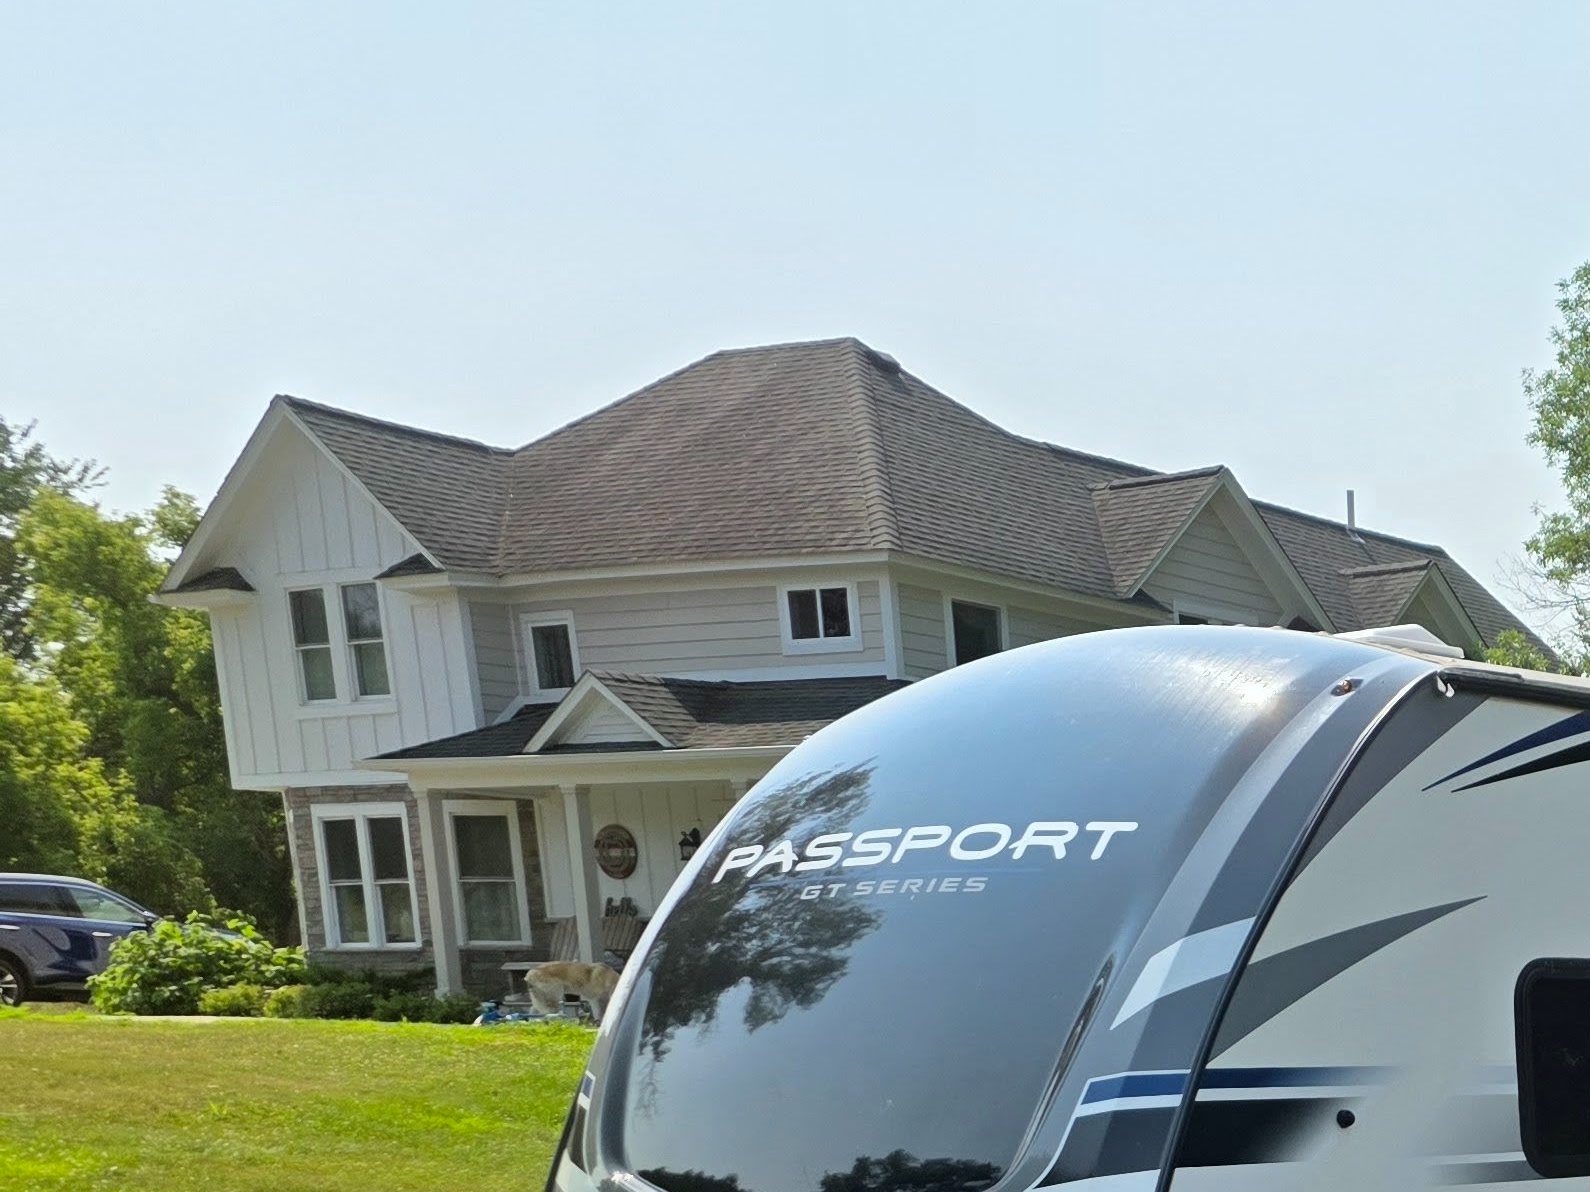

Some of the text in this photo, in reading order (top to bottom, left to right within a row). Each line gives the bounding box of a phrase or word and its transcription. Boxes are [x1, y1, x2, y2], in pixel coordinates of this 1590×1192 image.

[712, 821, 1139, 884] PASSPORT
[800, 877, 989, 901] GT SERIES
